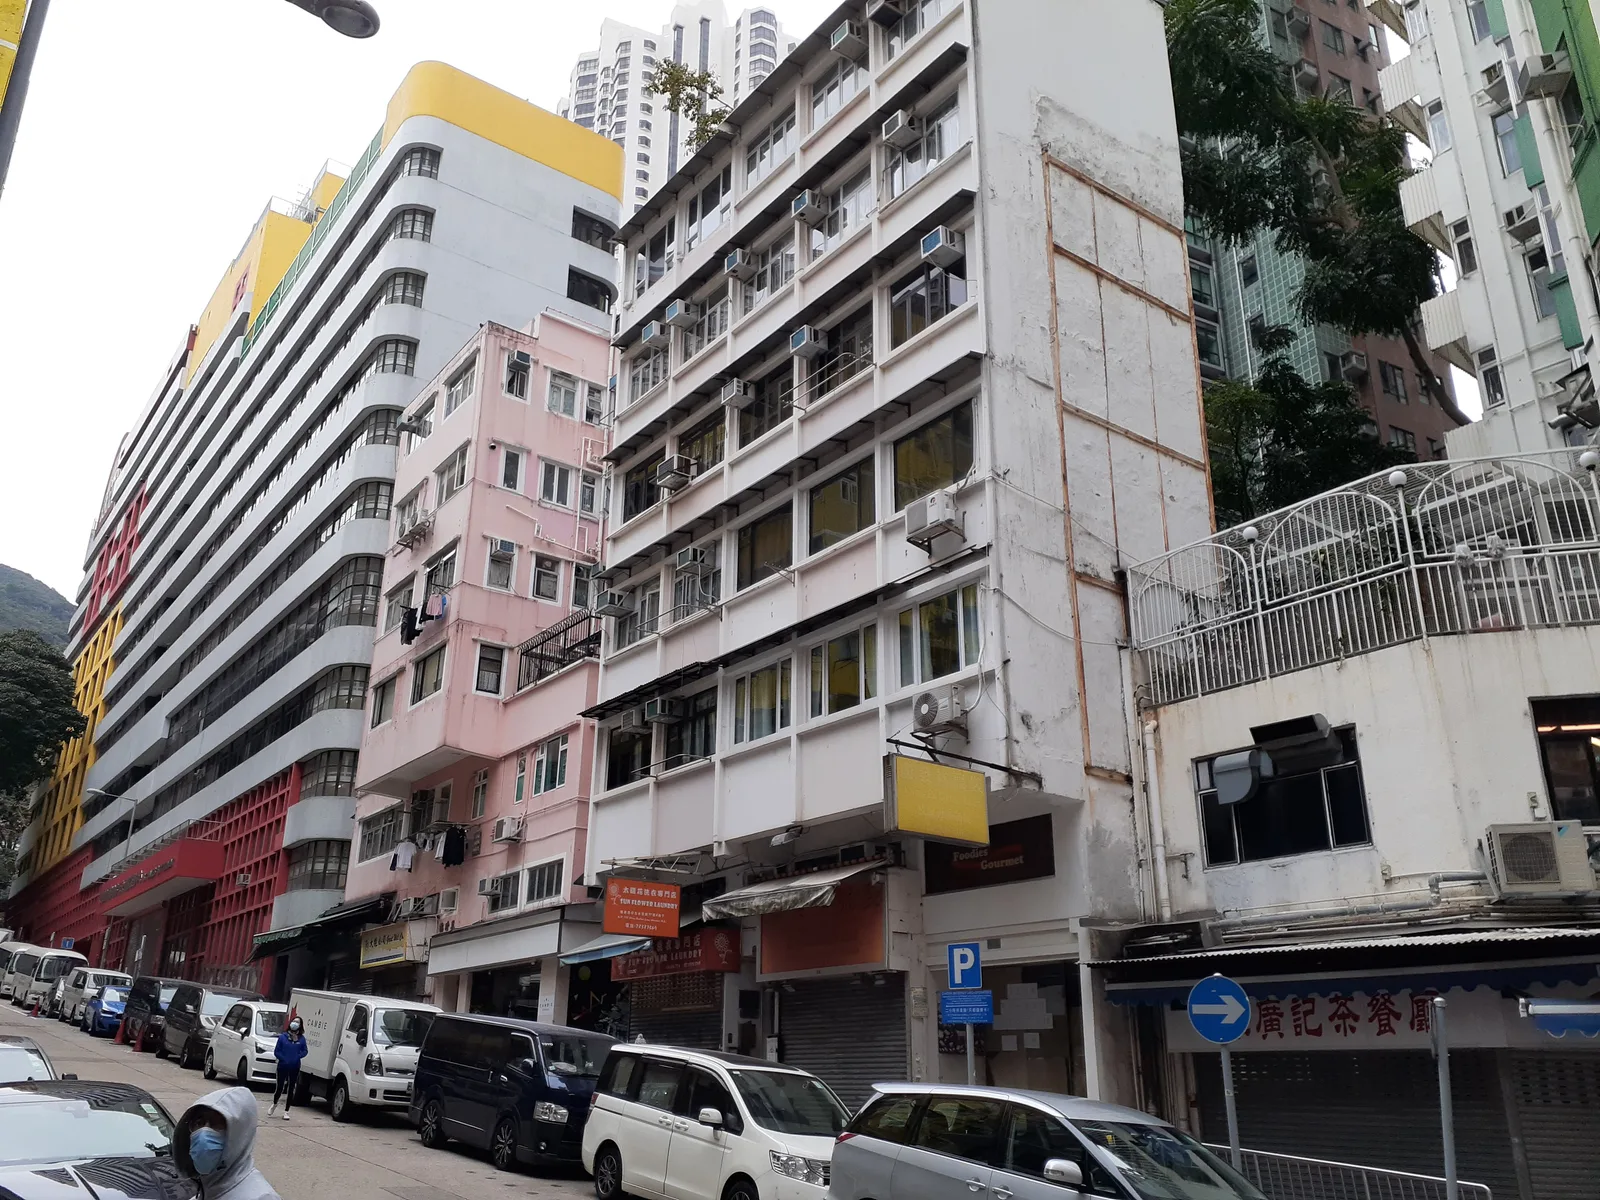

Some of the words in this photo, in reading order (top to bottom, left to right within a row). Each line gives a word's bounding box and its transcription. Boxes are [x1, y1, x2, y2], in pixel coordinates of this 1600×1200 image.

[952, 847, 989, 862] Foodies
[980, 855, 1025, 870] Gourmet
[631, 898, 654, 907] FLOWER
[654, 901, 678, 910] LAUNDRY
[953, 947, 975, 984] P
[307, 1018, 328, 1030] CAMBIE
